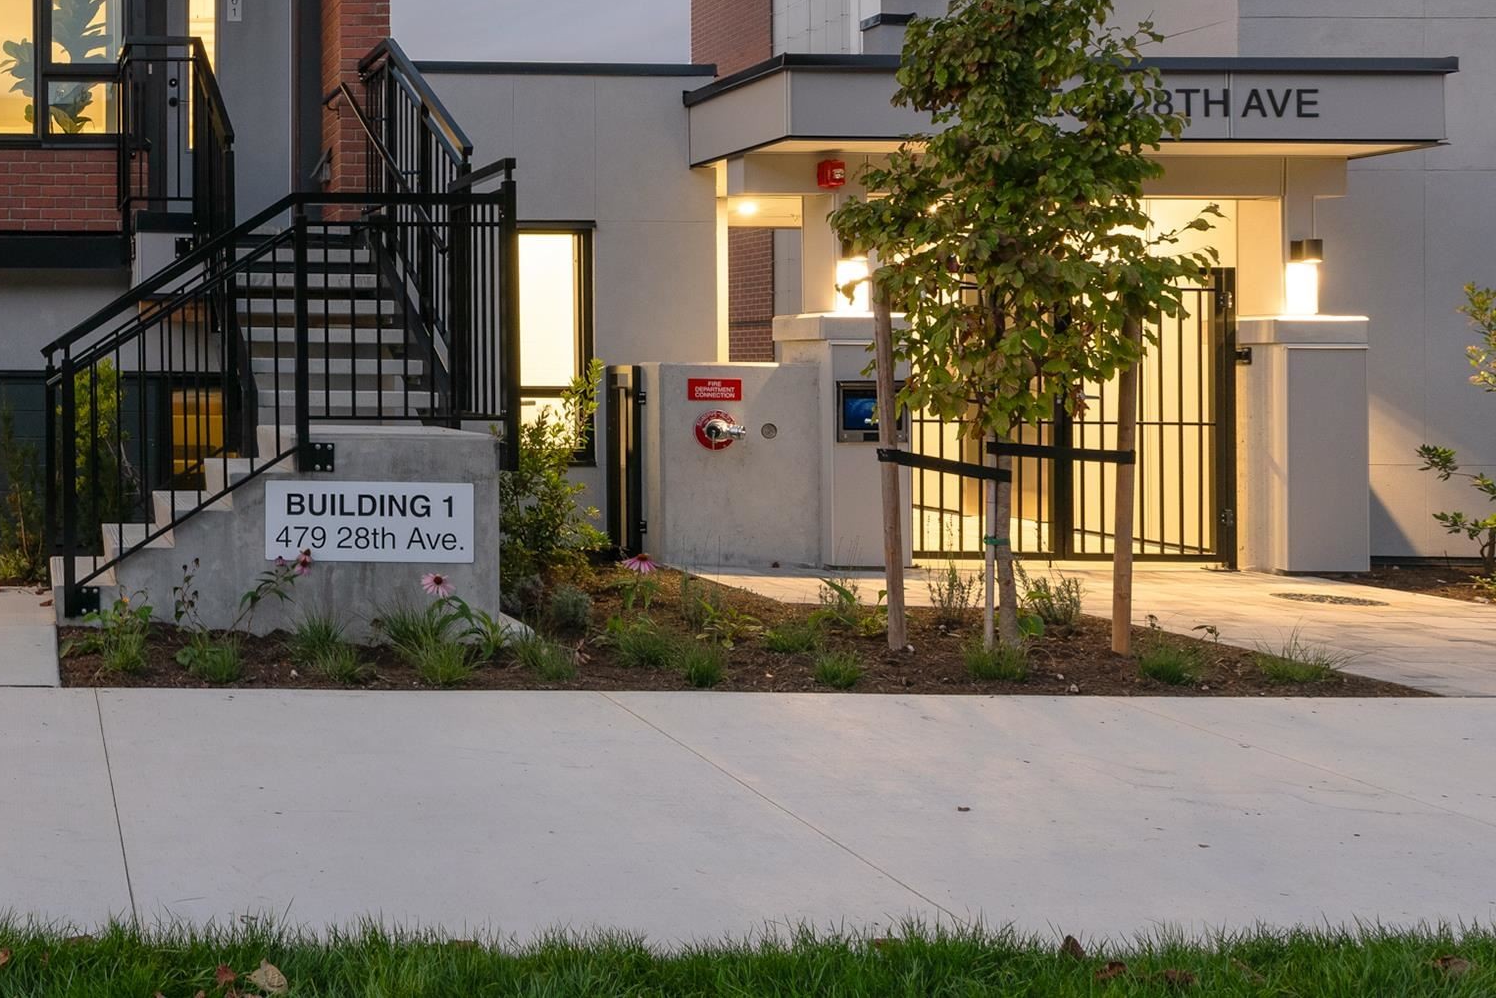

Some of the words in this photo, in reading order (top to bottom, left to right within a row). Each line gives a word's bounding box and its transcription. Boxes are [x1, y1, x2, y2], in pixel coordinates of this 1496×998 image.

[1241, 88, 1320, 118] AVE
[286, 493, 432, 518] BUILDING
[442, 495, 454, 518] 1
[275, 526, 327, 549] 479
[336, 526, 397, 550] 28th
[406, 527, 465, 551] Ave.
